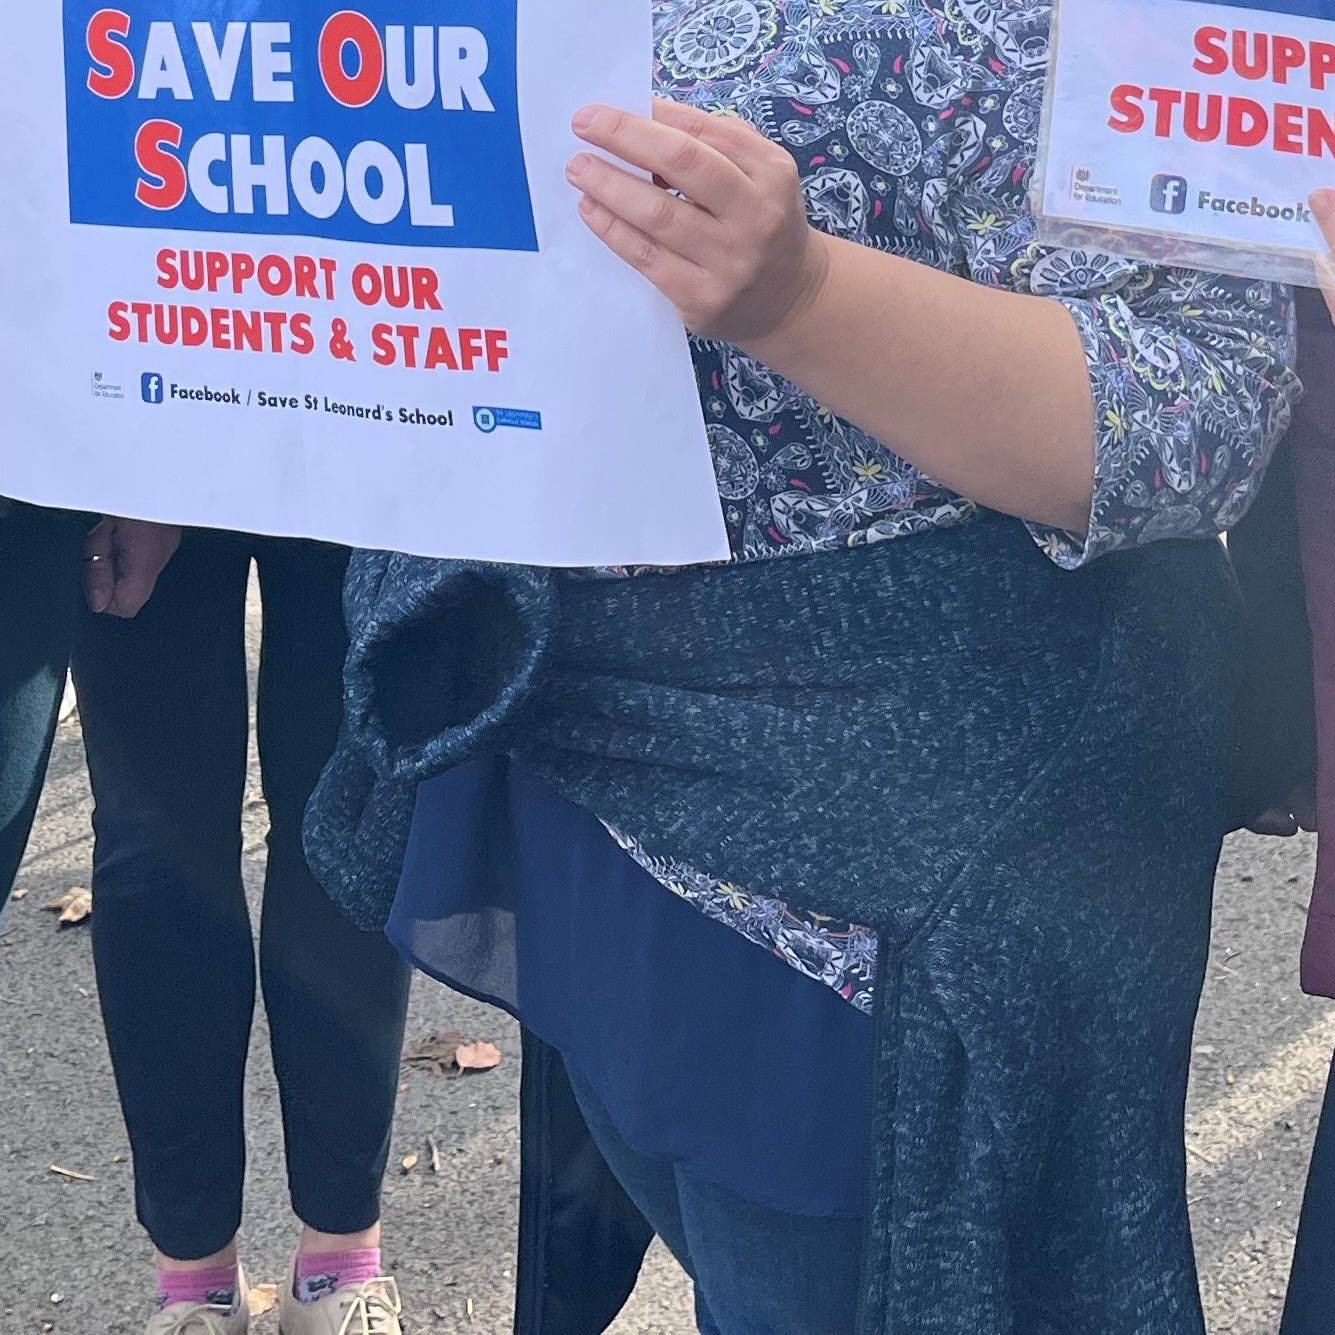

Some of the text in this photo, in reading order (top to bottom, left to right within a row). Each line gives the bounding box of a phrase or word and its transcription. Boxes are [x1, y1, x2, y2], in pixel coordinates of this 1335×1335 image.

[85, 8, 495, 113] SAVE OUR
[134, 118, 455, 227] SCHOOL
[1198, 191, 1310, 223] Facebook
[156, 248, 442, 310] SUPPORT OUR
[107, 301, 509, 373] STUDENTS & STAFF
[170, 384, 241, 405] Facebook
[257, 391, 299, 409] Save
[304, 393, 319, 410] St
[324, 396, 393, 421] Leonard's
[399, 407, 454, 426] School
